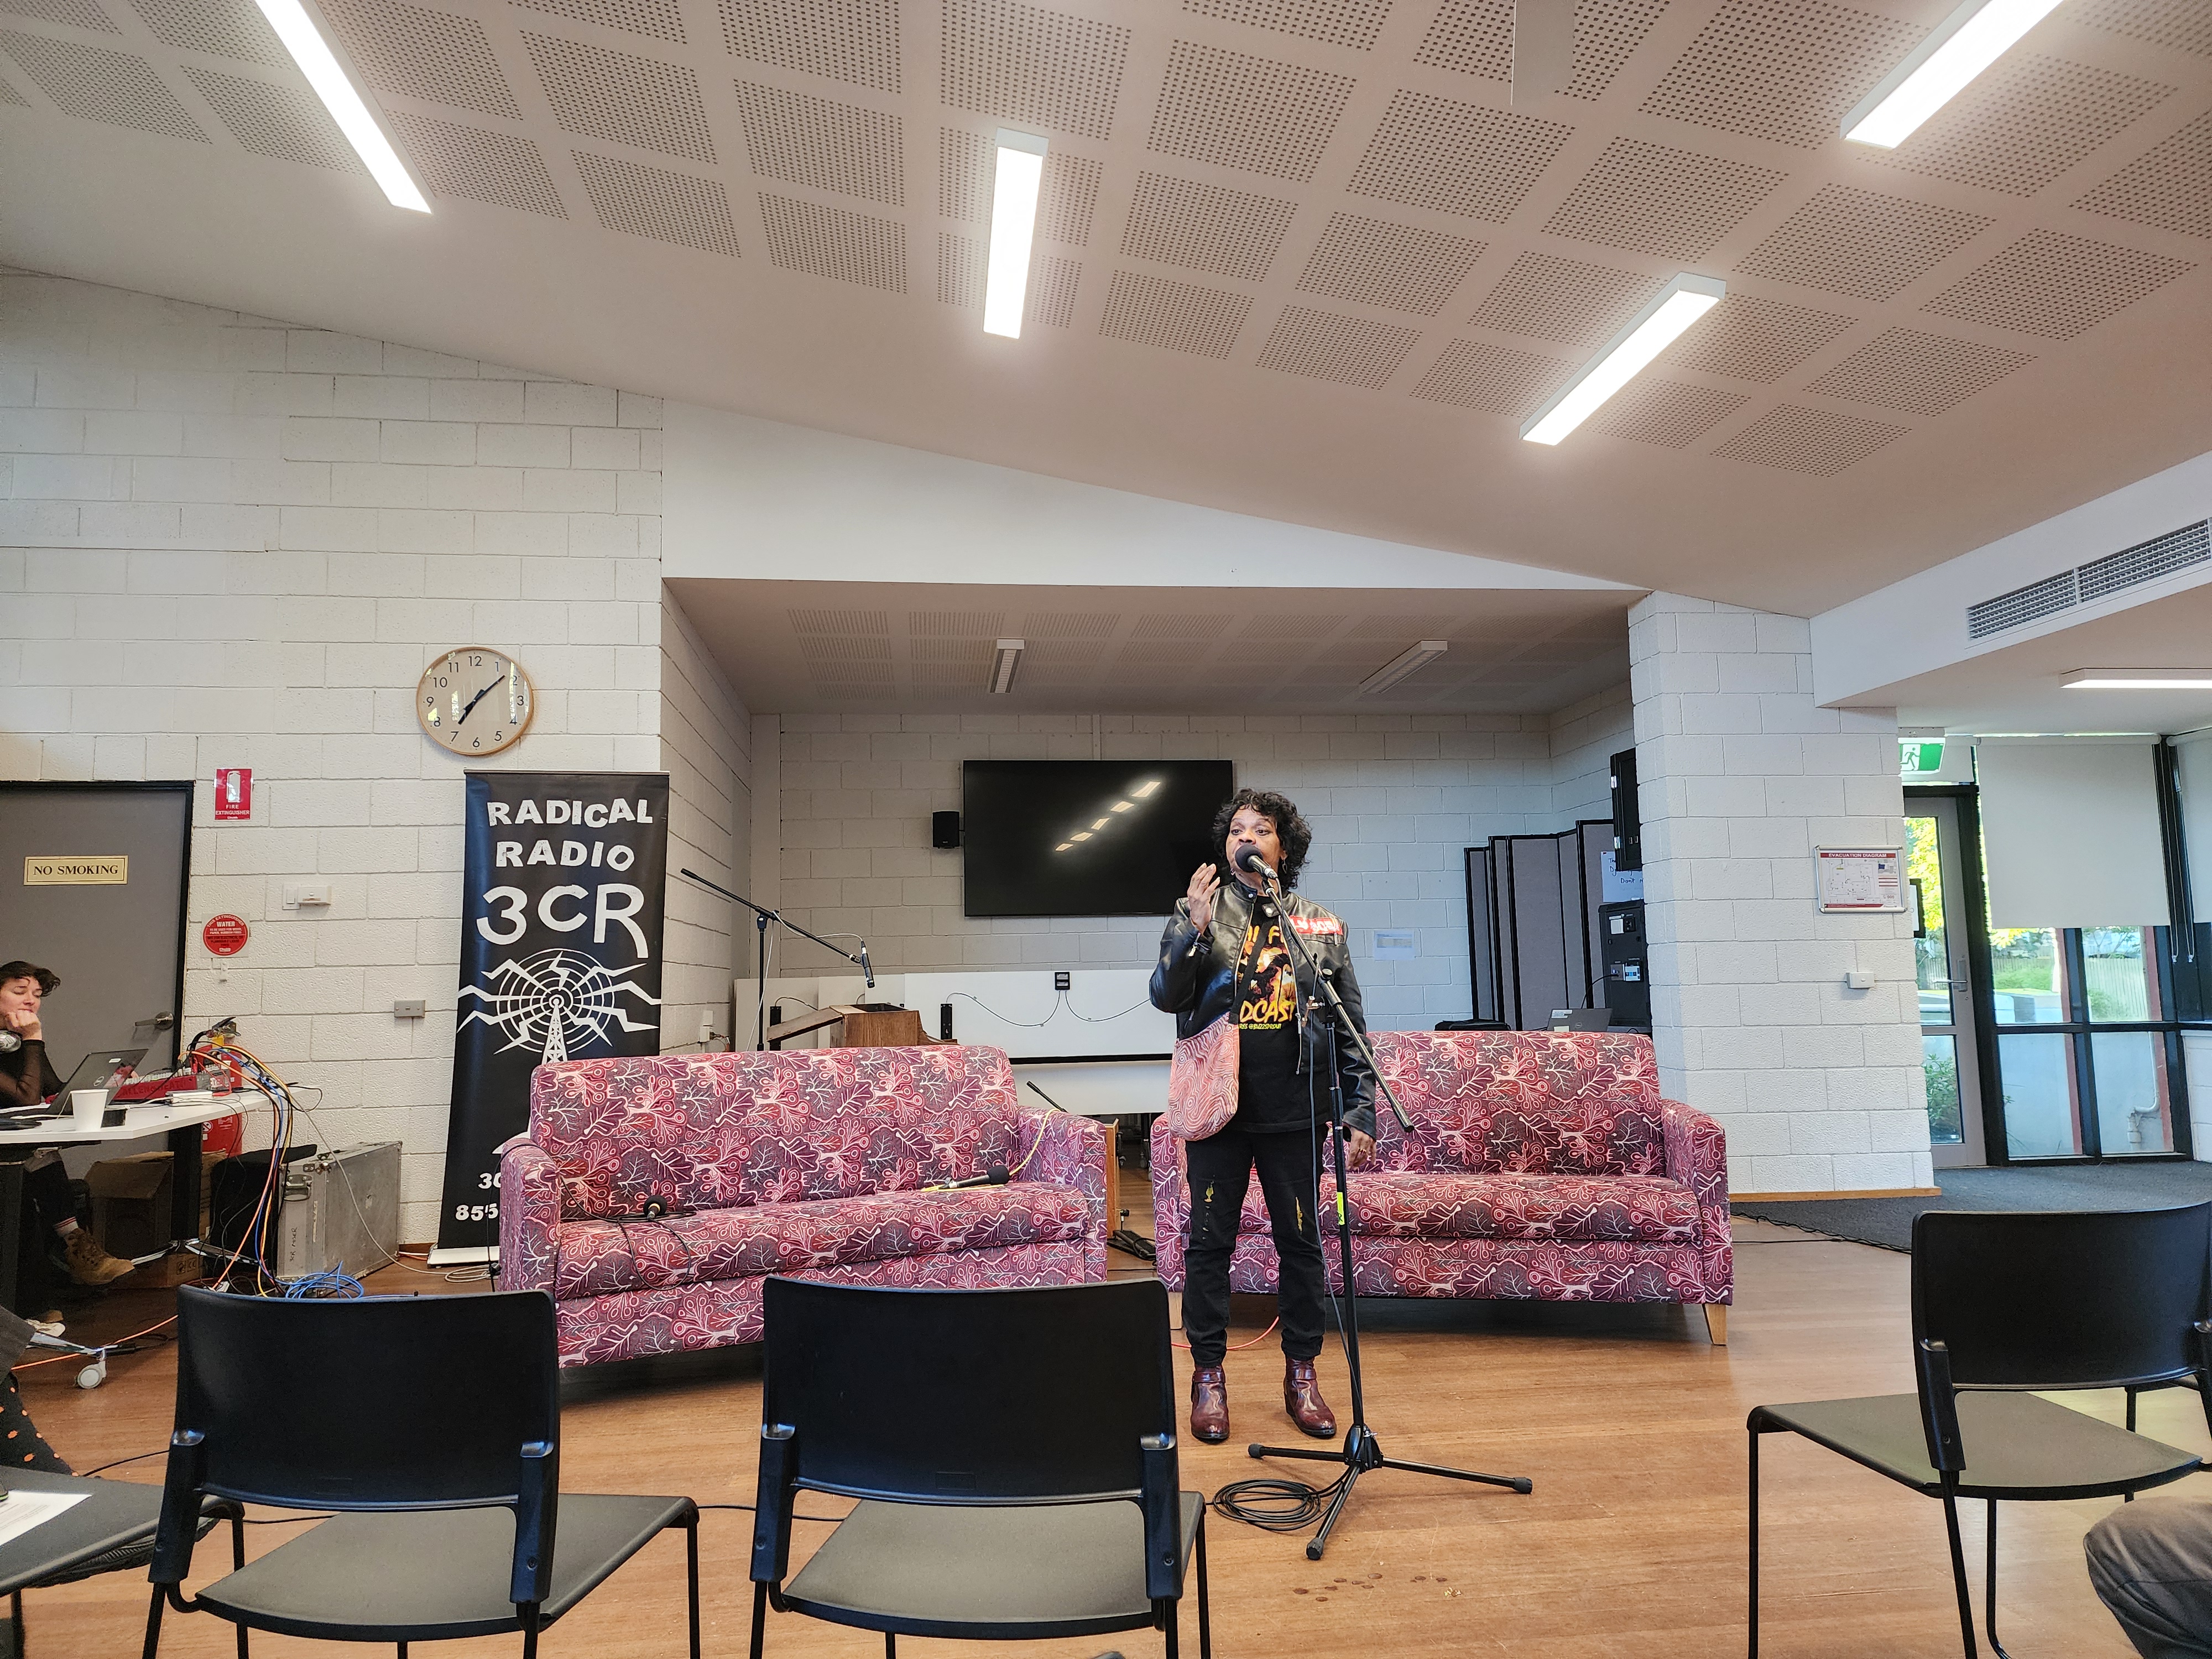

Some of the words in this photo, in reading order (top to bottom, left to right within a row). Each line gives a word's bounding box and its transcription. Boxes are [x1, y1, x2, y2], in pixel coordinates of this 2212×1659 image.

[468, 656, 482, 667] 12
[495, 661, 499, 672] 1
[448, 662, 459, 673] 11
[434, 677, 448, 688] 10
[426, 696, 434, 707] 9
[517, 695, 524, 706] 3
[434, 716, 441, 727] 8
[450, 731, 459, 742] 7
[494, 731, 502, 742] 5
[472, 737, 480, 748] 6
[487, 797, 654, 828] RADICAL
[495, 839, 635, 872] RADIO
[34, 866, 53, 875] NO
[57, 865, 118, 875] SMOKING
[476, 883, 649, 958] 3CR
